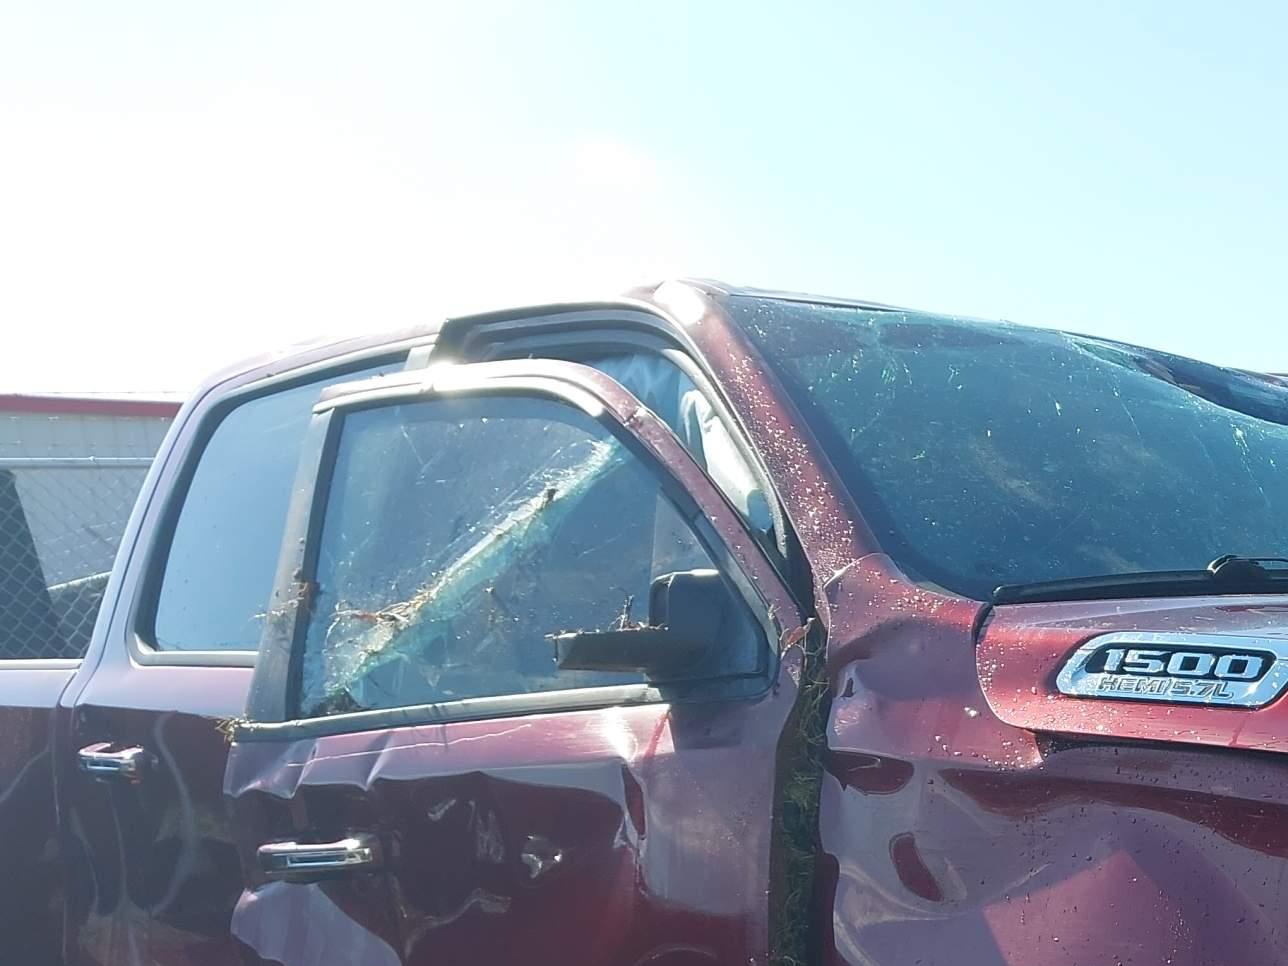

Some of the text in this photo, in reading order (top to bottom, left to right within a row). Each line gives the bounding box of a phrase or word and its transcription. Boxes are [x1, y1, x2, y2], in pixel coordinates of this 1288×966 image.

[1103, 648, 1265, 679] 1500
[1098, 675, 1234, 699] HEMI 5.7L
